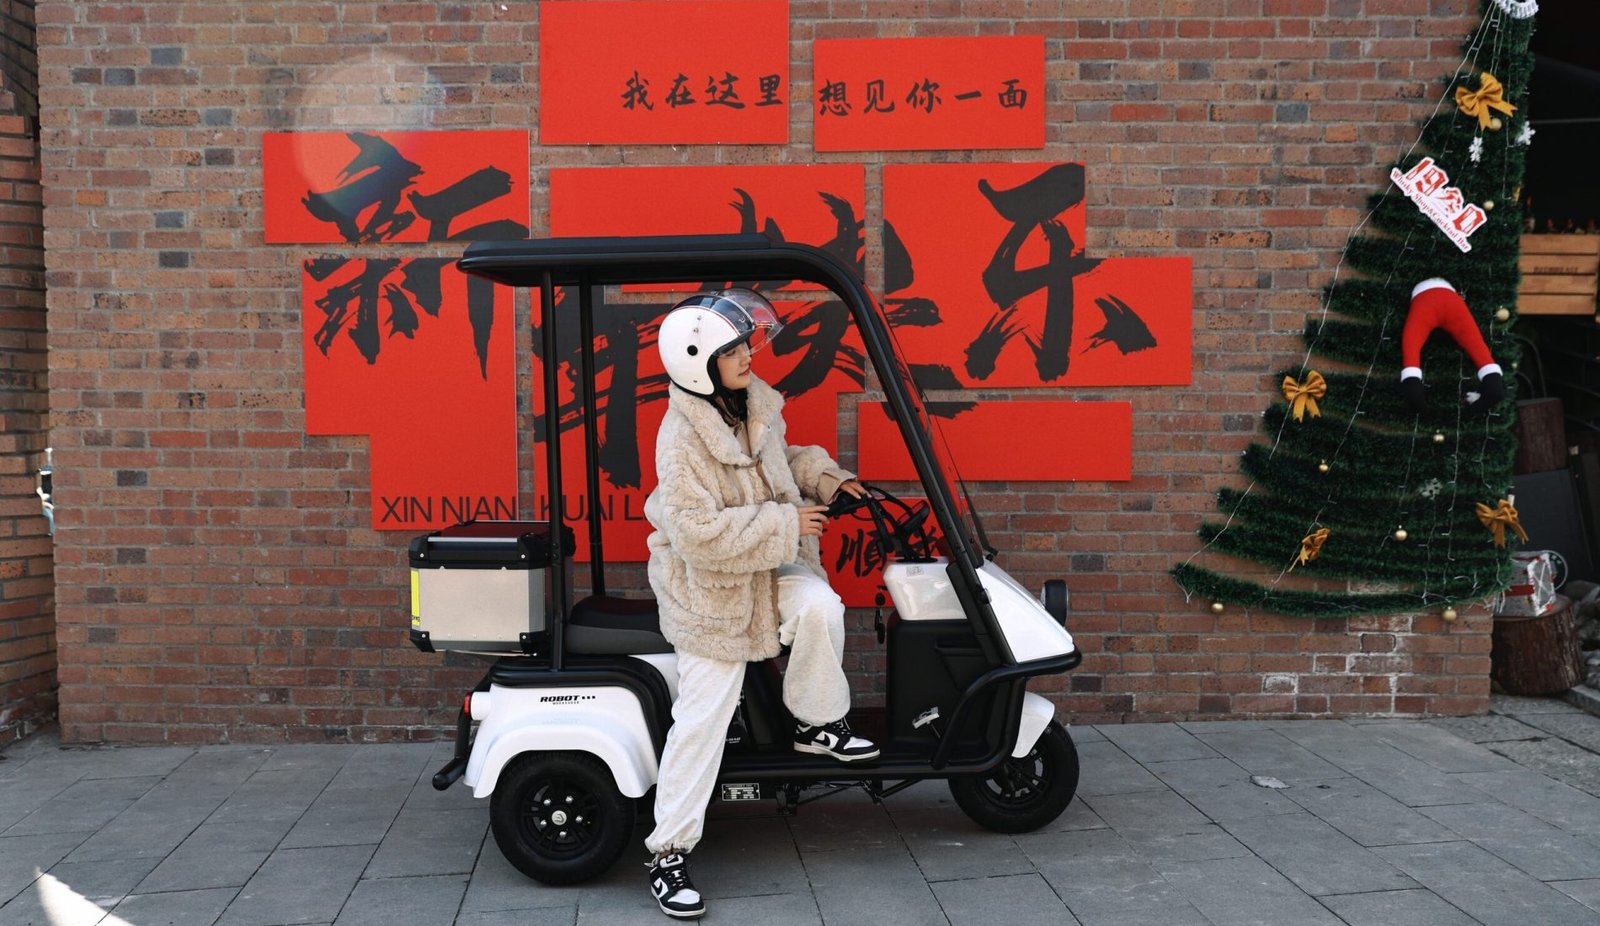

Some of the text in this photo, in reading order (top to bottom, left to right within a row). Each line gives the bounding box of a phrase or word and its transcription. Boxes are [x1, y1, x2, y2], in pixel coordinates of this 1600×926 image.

[621, 71, 1029, 116] 我在这里 想见你一面
[380, 496, 432, 523] XIN
[441, 495, 517, 523] NIAN
[540, 695, 580, 703] ROBOT
